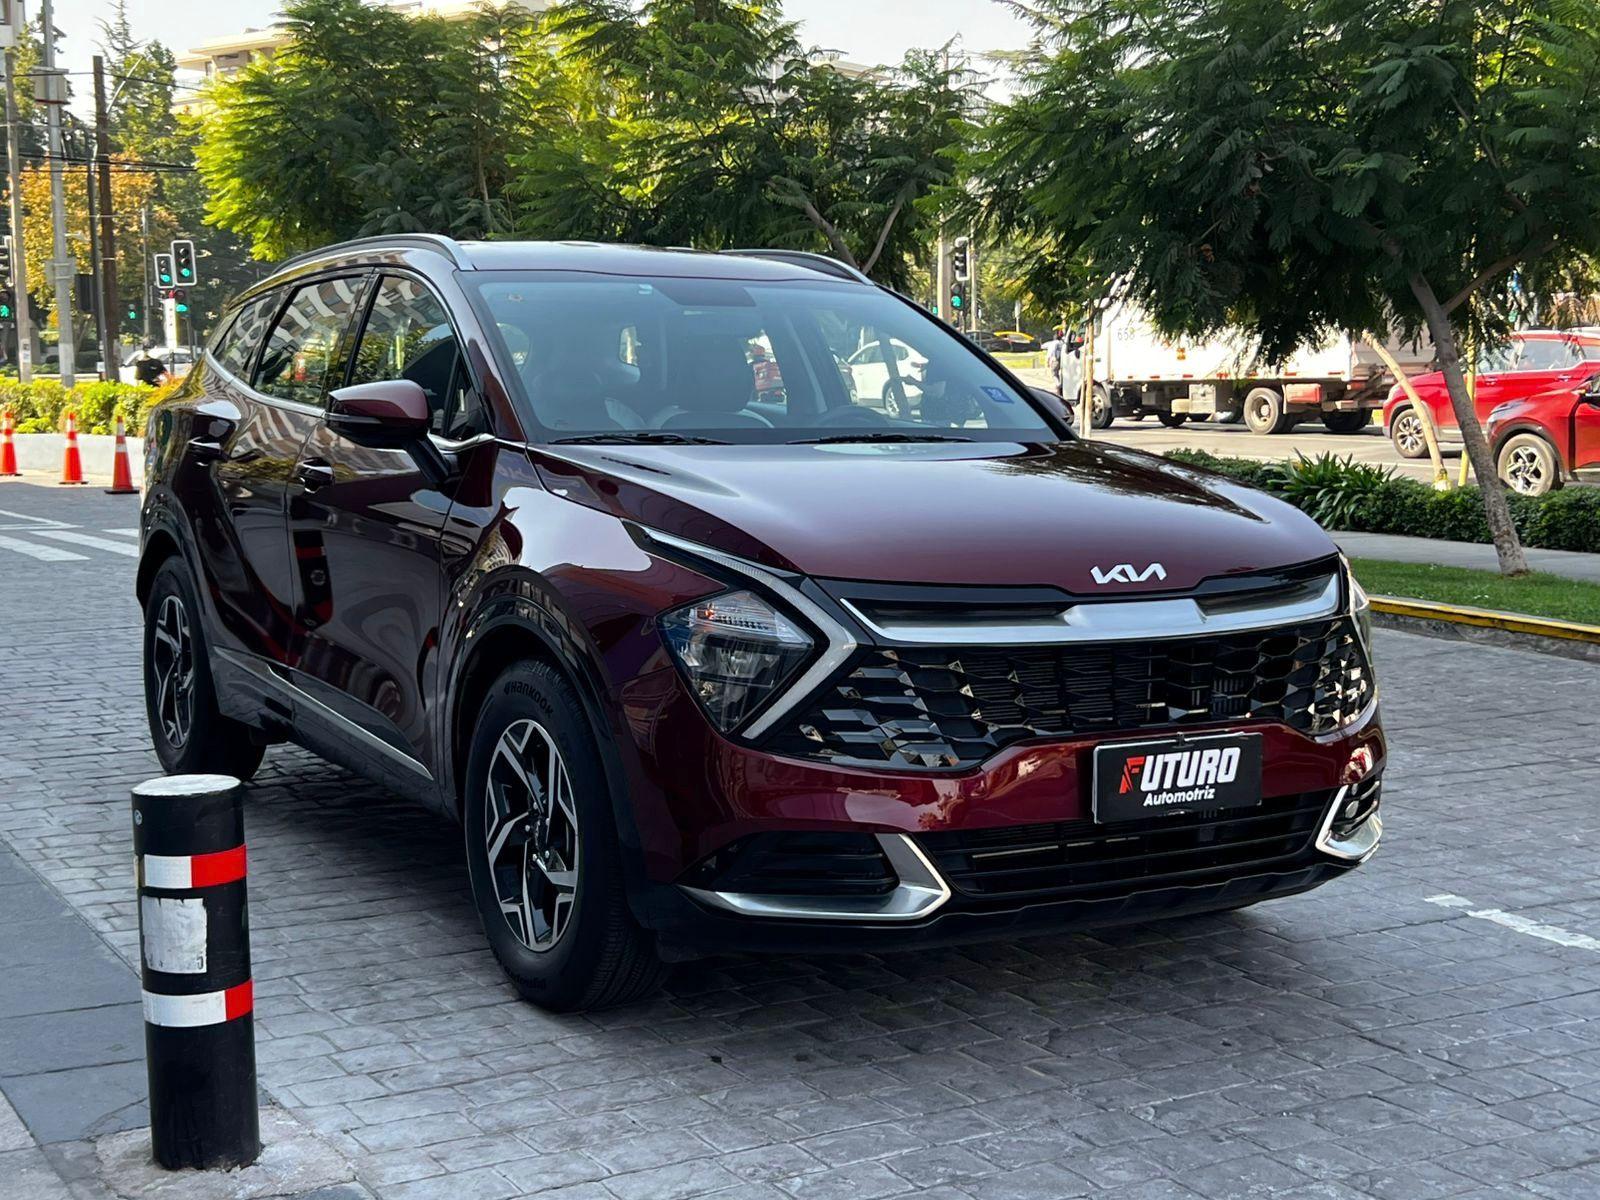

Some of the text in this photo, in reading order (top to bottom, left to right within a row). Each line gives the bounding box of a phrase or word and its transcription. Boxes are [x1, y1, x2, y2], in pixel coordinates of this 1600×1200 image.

[1090, 562, 1167, 584] KIA
[1119, 746, 1241, 794] FUTURO
[1143, 785, 1216, 807] Automotriz
